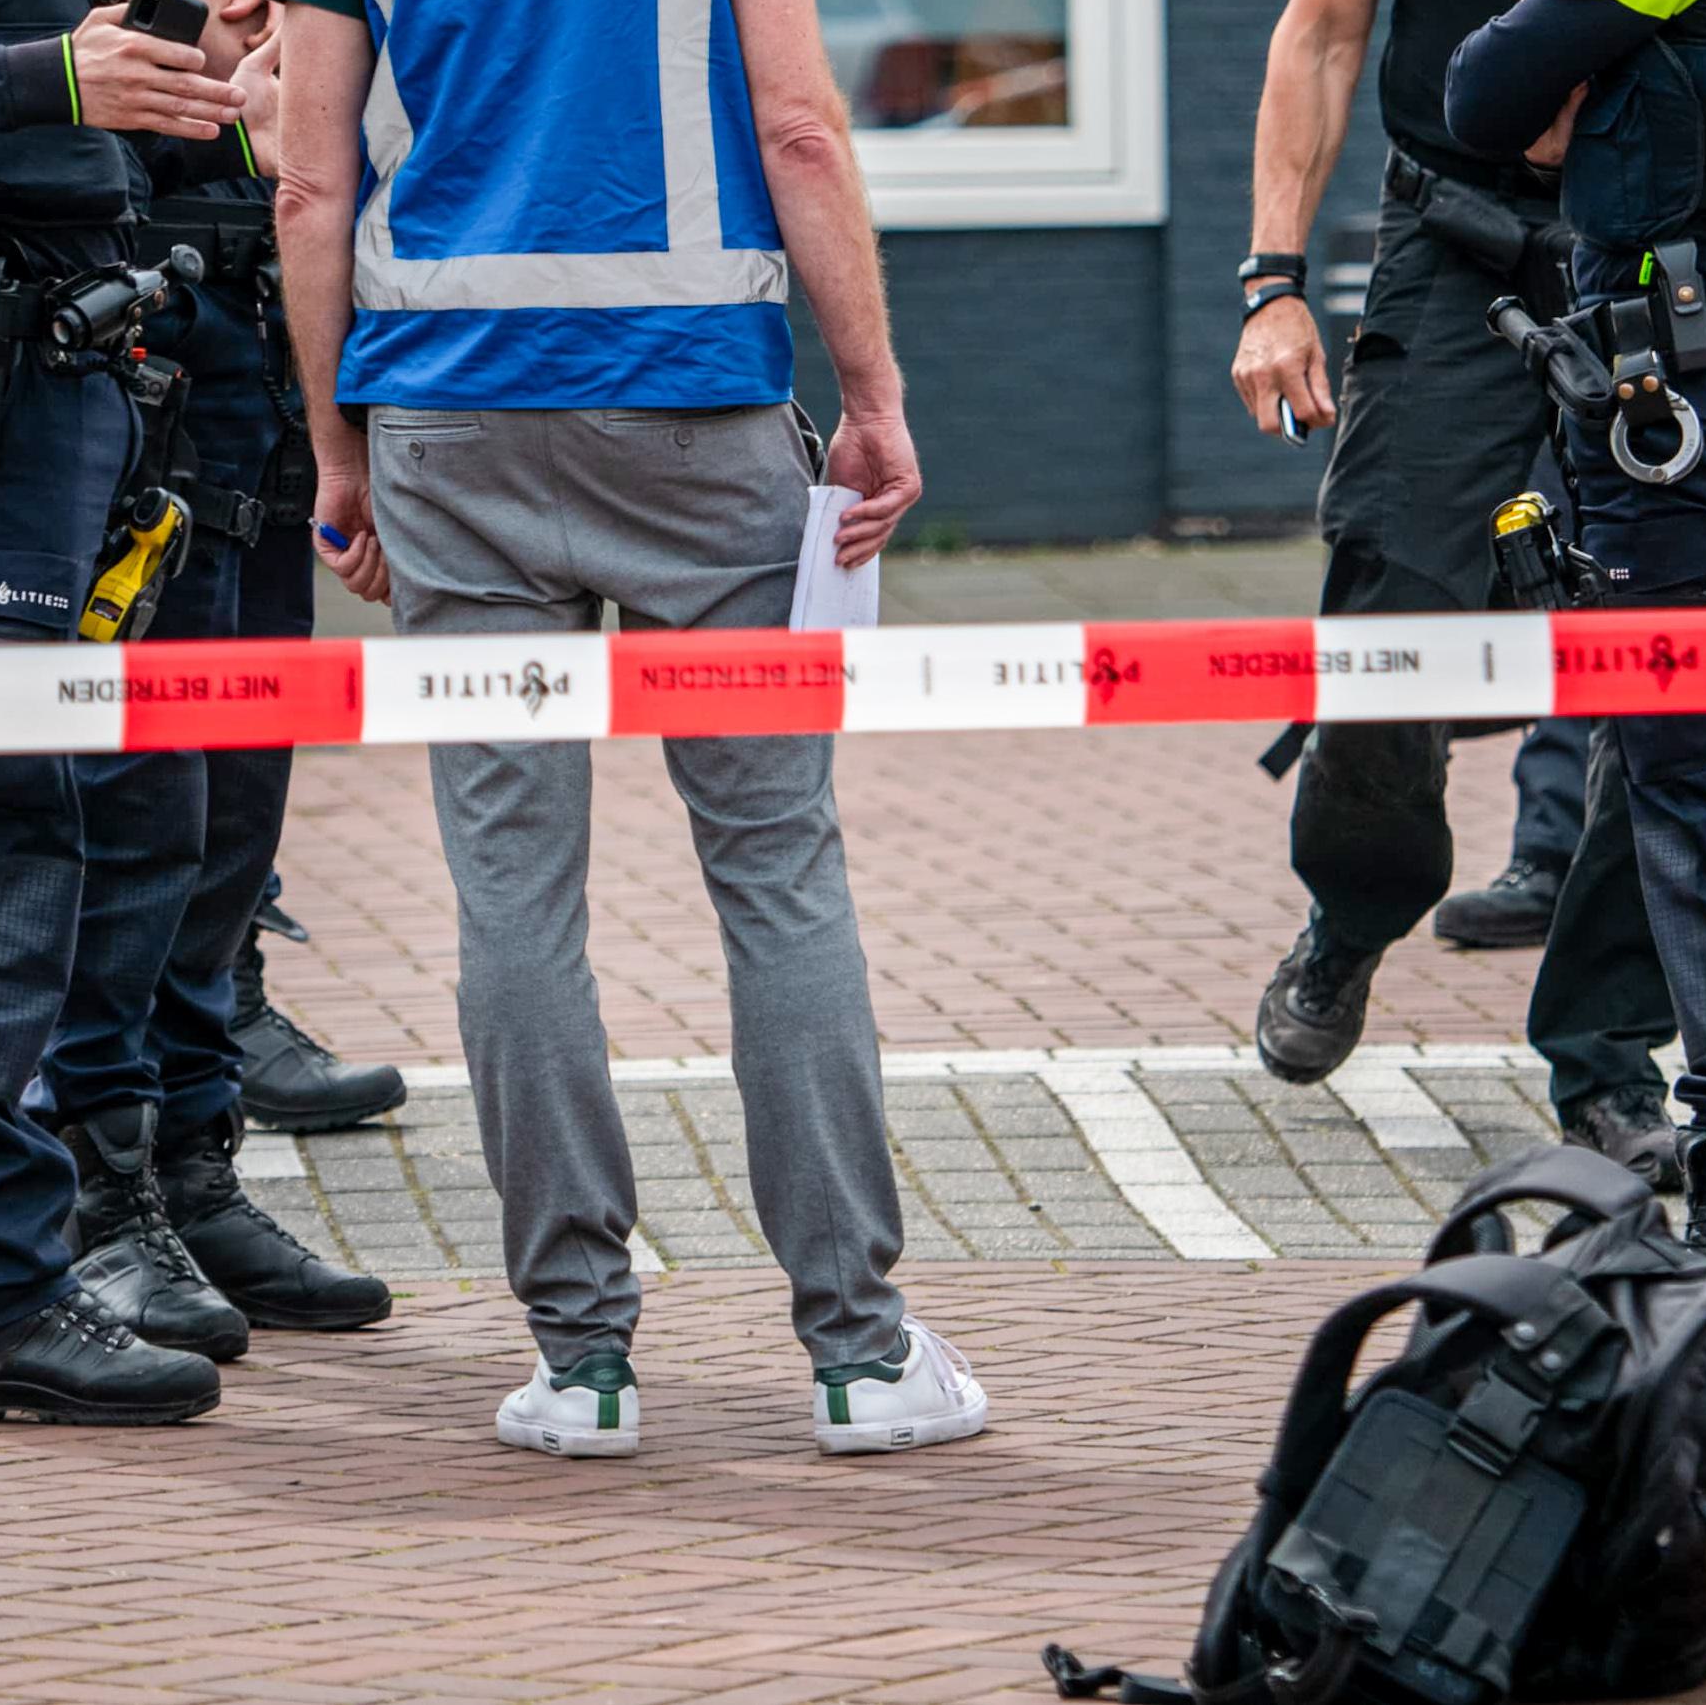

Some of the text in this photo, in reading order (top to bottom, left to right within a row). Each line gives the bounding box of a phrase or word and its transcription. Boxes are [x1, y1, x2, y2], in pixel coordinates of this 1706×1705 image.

[641, 663, 856, 691] NIET BETREDEN
[1208, 650, 1420, 677] NIET BETREDEN
[58, 675, 281, 704] NIET BETREDEN
[418, 661, 571, 699] POLITIE
